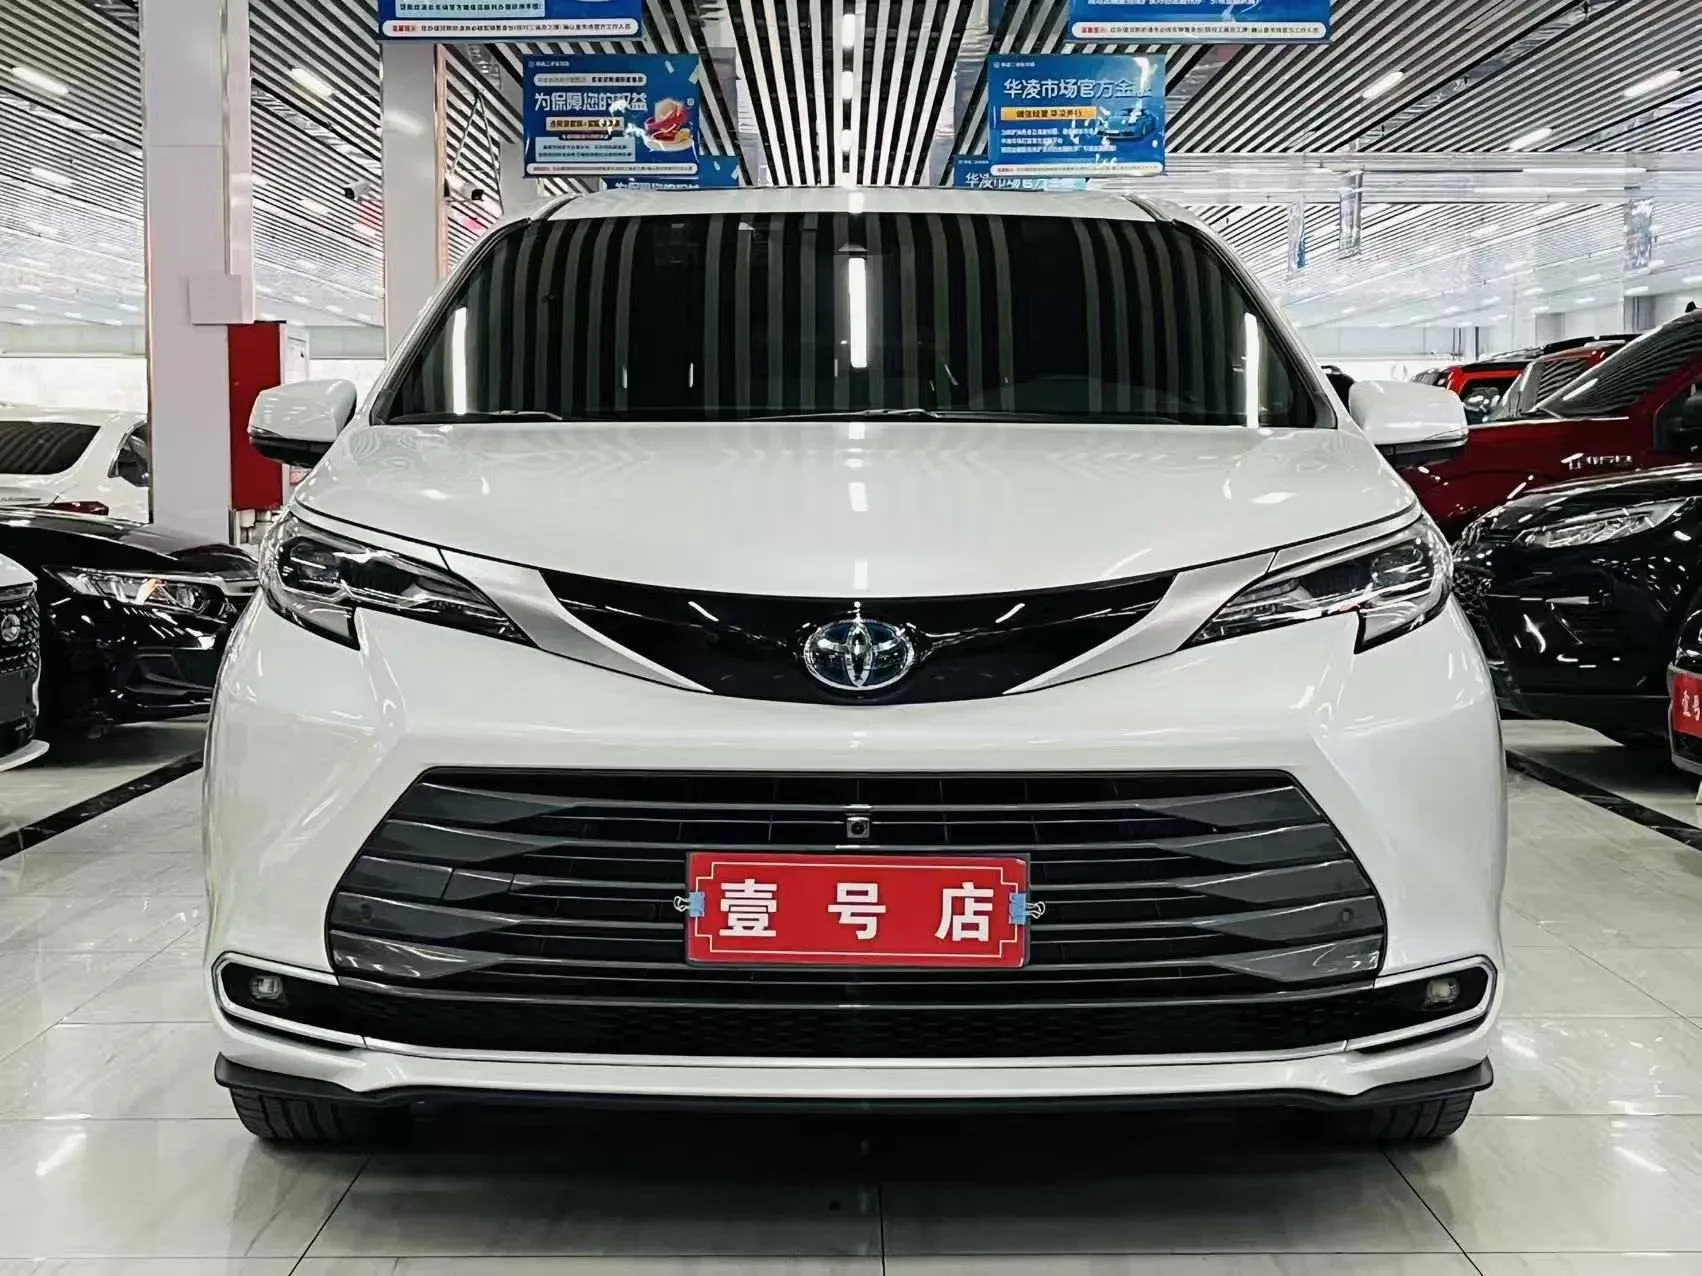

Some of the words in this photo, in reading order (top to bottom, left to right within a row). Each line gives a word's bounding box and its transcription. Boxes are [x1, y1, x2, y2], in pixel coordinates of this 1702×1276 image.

[1003, 77, 1152, 99] 华凌市场官方金
[719, 878, 994, 942] 壹号店
